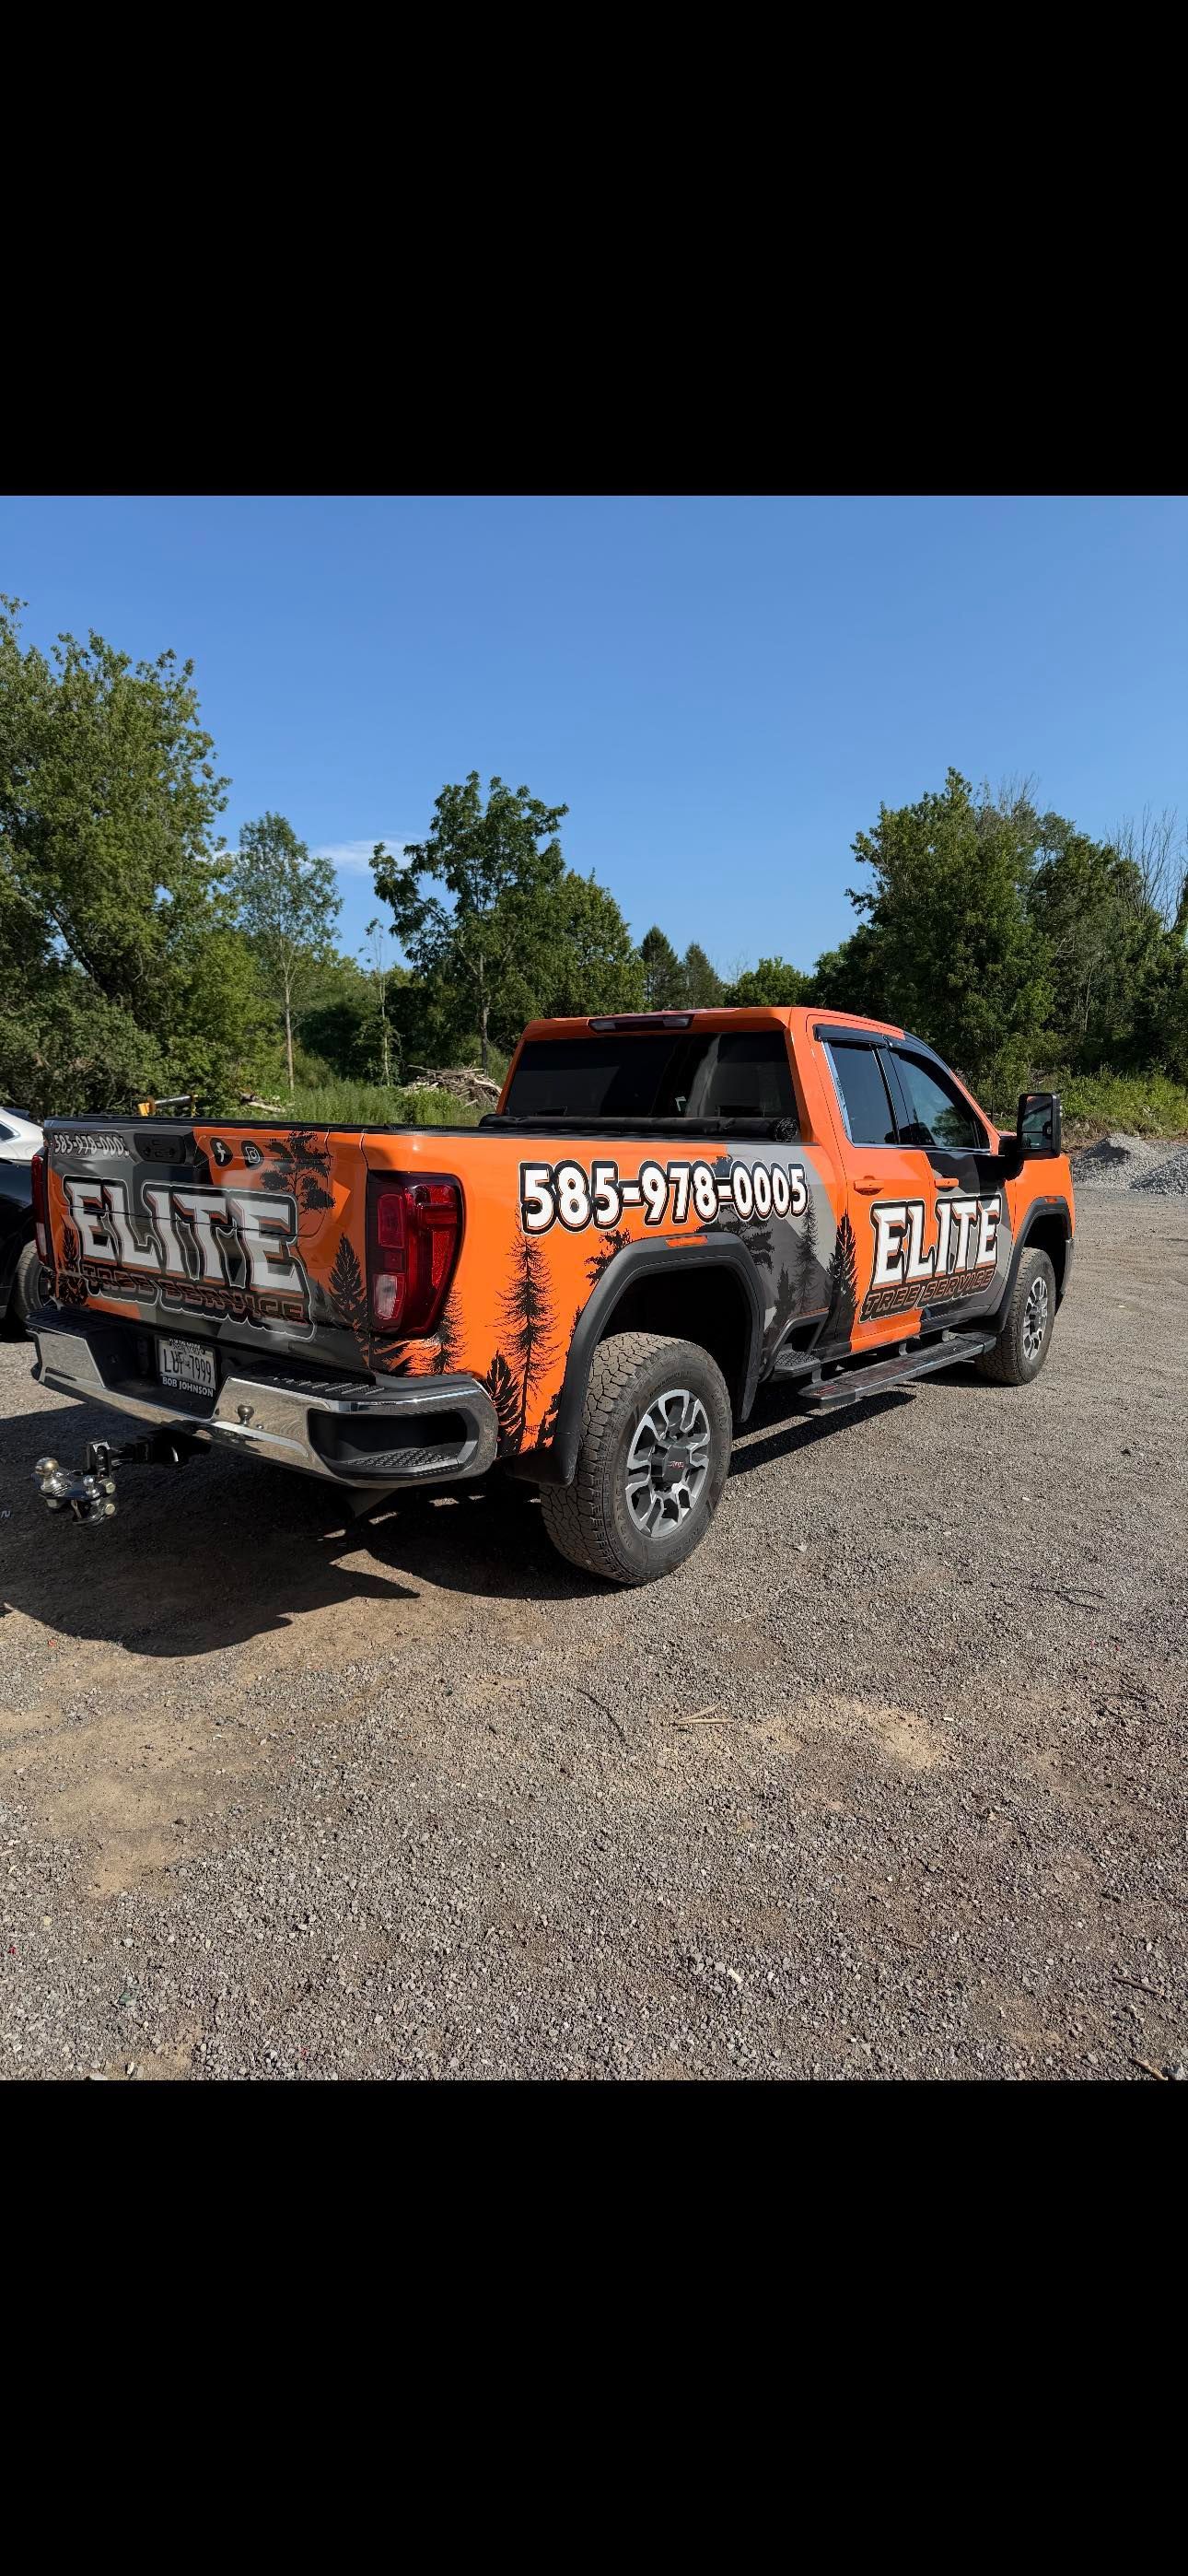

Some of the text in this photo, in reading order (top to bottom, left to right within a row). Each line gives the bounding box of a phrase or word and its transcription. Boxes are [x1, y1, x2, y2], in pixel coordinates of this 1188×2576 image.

[521, 1162, 807, 1233] 585-978-0005
[65, 1182, 305, 1298] ELITE
[872, 1199, 1000, 1290] ELITE
[864, 1269, 995, 1315] TREE SERVICE
[162, 1376, 178, 1388] BOB
[179, 1380, 214, 1397] JOHNSON
